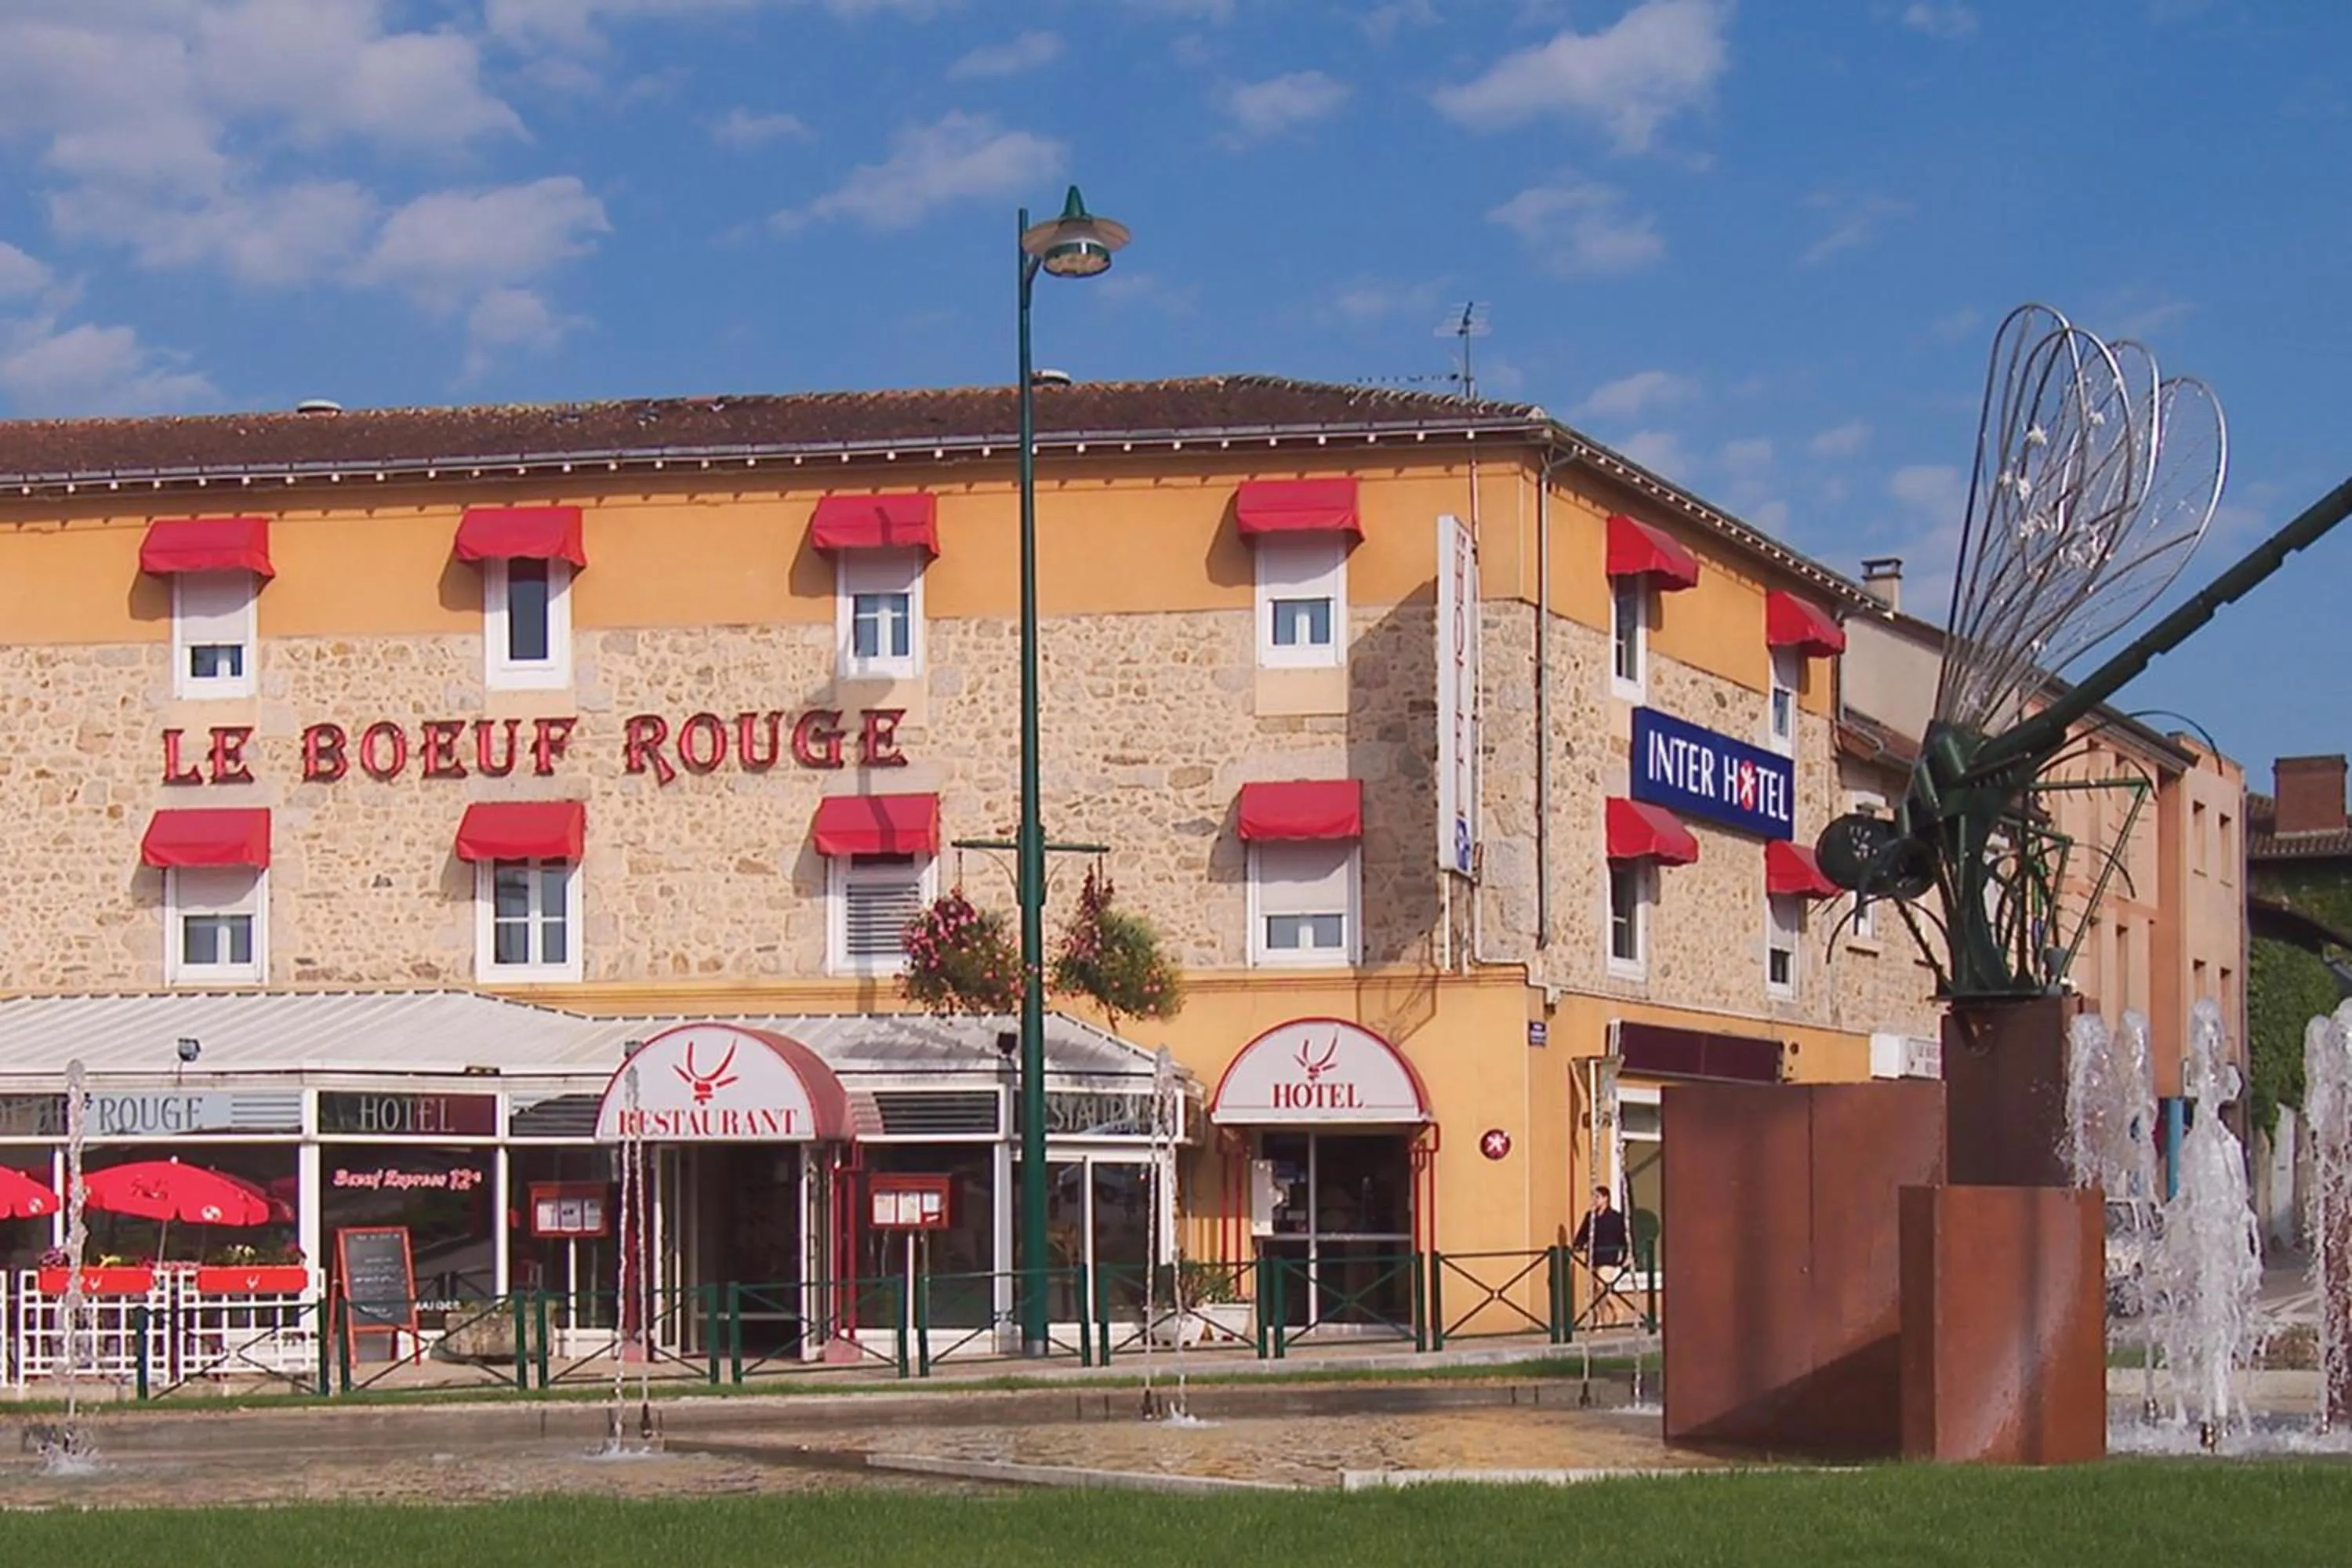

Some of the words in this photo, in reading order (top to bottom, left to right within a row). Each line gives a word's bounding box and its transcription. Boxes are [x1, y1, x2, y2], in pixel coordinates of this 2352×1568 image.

[162, 727, 253, 786] LE
[303, 717, 577, 782] BOEUF
[625, 710, 908, 786] ROUGE
[1649, 730, 1715, 797] INTER
[360, 1096, 456, 1131] HOTEL
[1273, 1083, 1364, 1109] HOTEL
[99, 1097, 204, 1132] ROUGE
[619, 1109, 798, 1136] RESTAURANT
